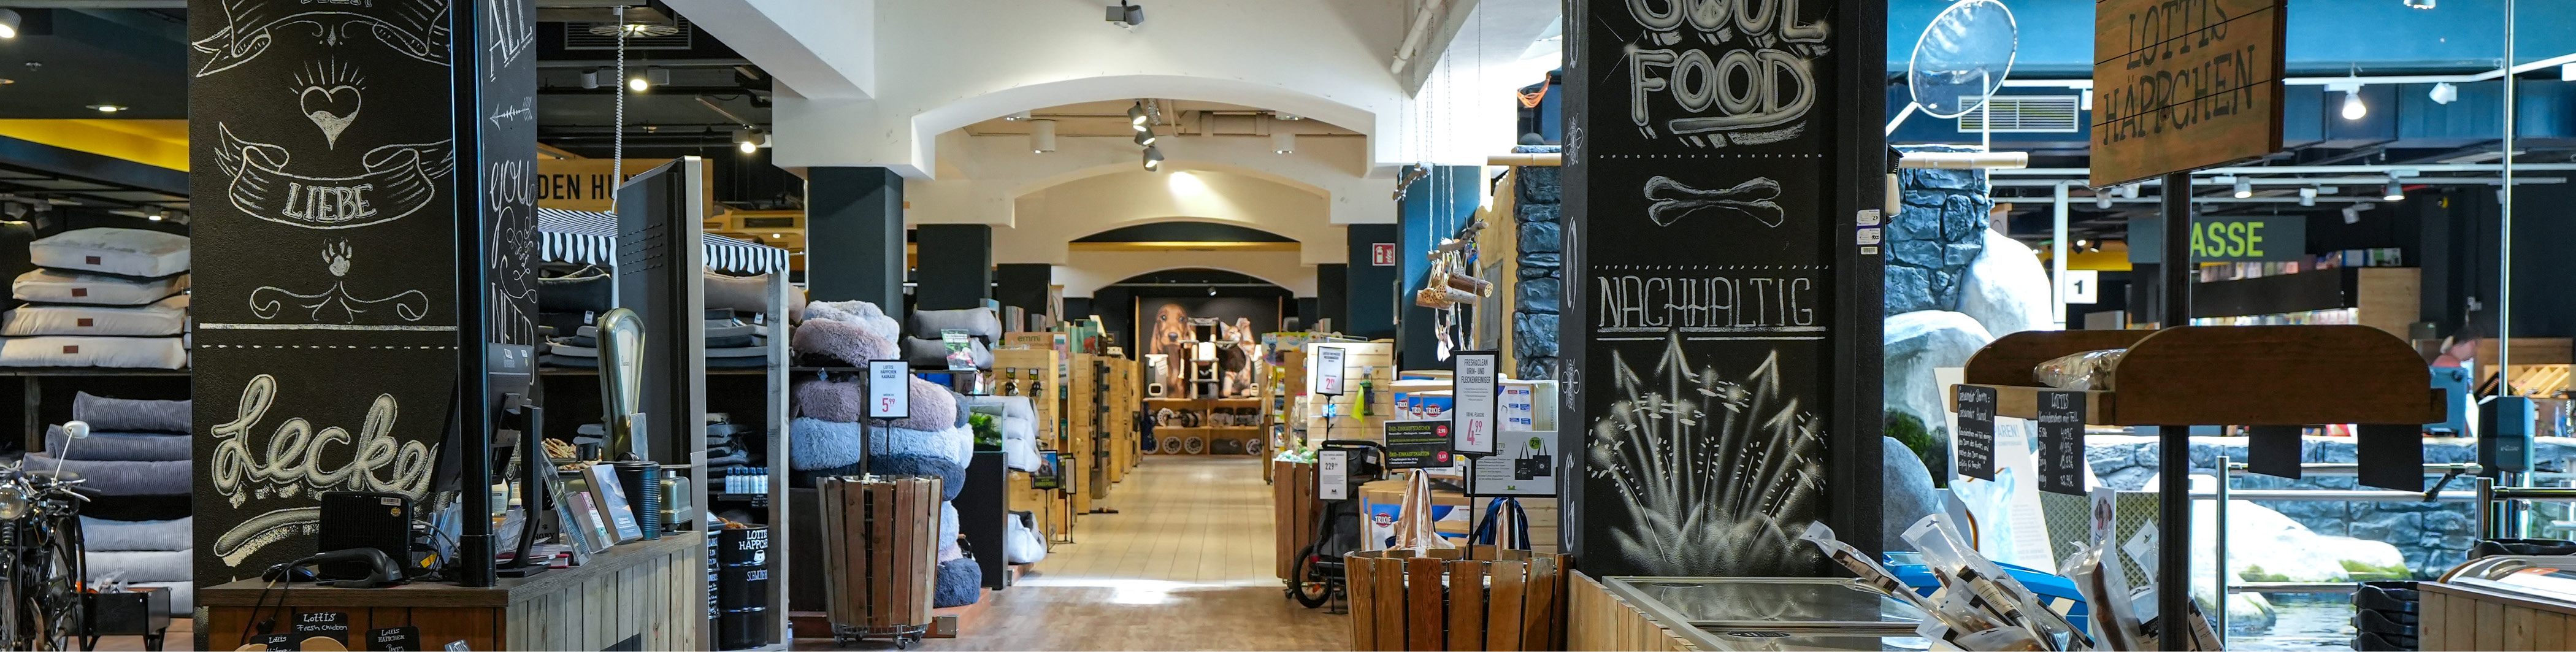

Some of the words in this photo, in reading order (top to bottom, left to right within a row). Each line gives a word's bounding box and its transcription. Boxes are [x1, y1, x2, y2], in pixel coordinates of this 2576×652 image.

[2126, 0, 2227, 70] LOTTIS
[1630, 48, 1817, 134] FOOD
[2103, 44, 2255, 145] HÄPPCHEN
[282, 181, 377, 223] LIEBE
[538, 174, 580, 199] DEN
[2191, 221, 2264, 257] ASSE
[1597, 275, 1813, 327] NACHHALTIG
[2074, 280, 2083, 294] 1
[212, 374, 439, 500] Lecke
[535, 532, 556, 540] NGRY
[1374, 516, 1392, 524] TRIXIE
[738, 539, 768, 550] HÄPPCHE
